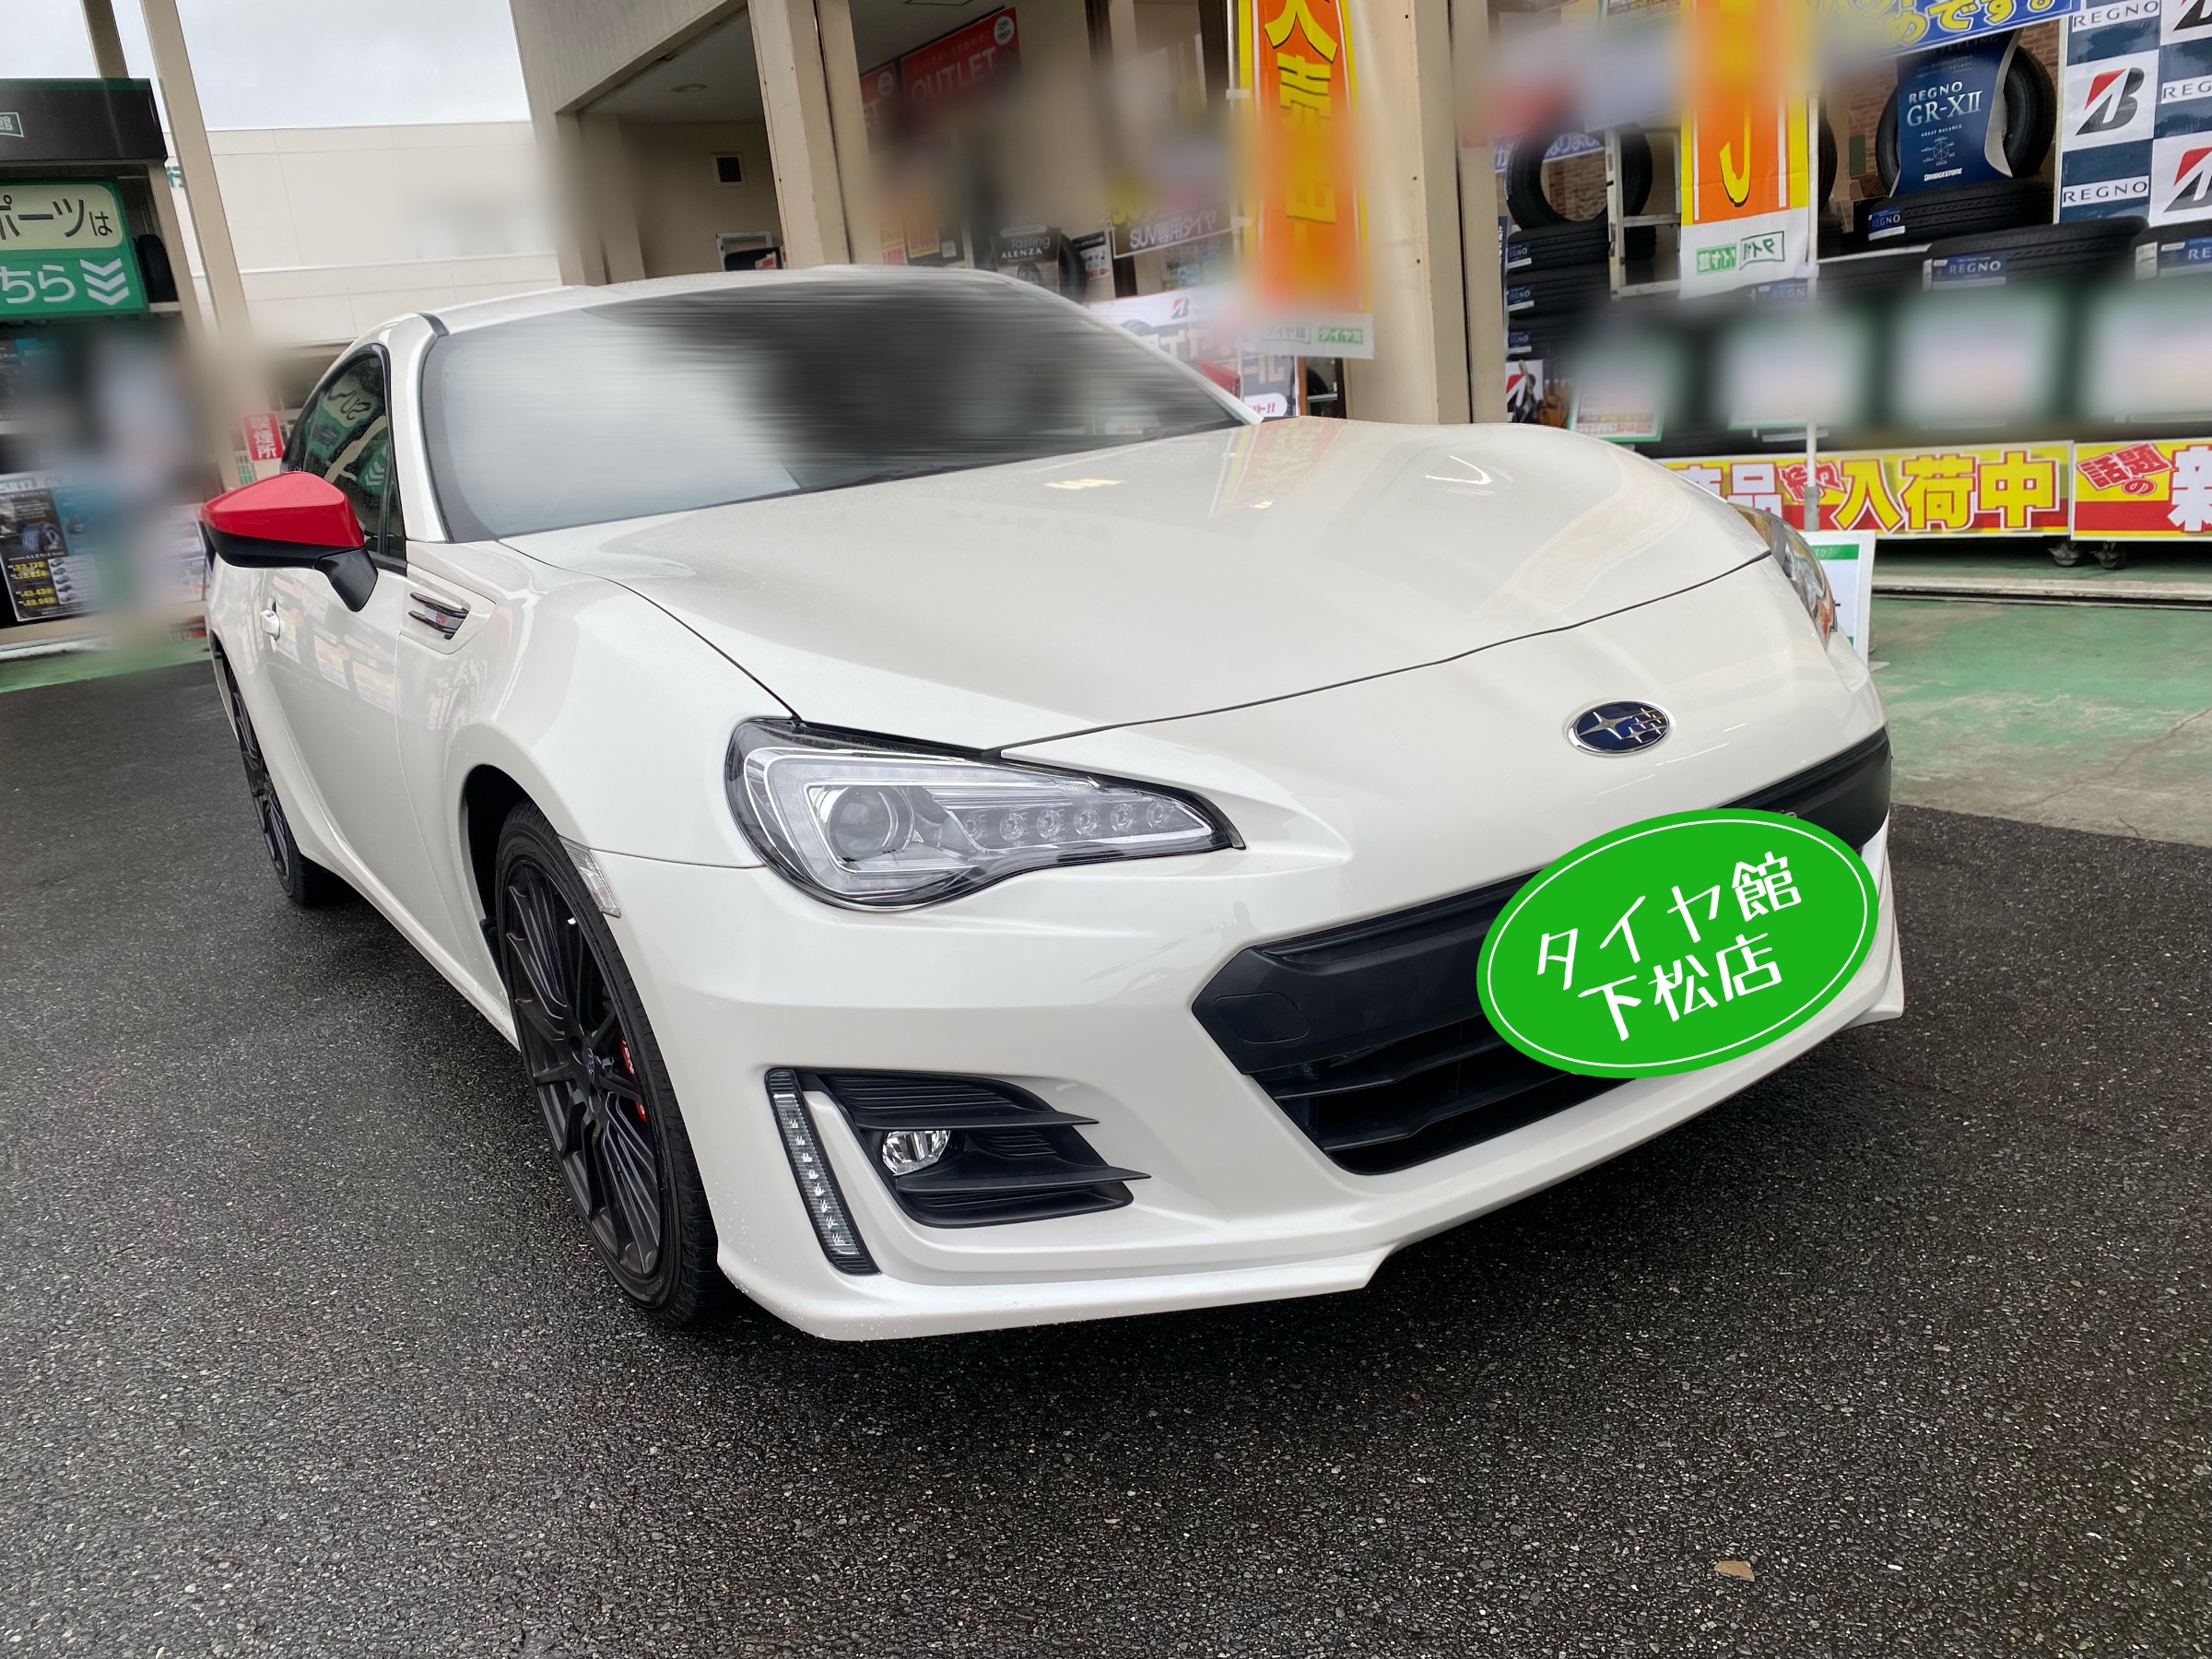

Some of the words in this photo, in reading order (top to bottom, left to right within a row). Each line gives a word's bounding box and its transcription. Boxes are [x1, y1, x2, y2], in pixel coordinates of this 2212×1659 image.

[2073, 1, 2159, 28] REGNO
[911, 46, 997, 103] OUTLET
[1908, 81, 1963, 103] REGNO
[1924, 168, 1963, 182] BRIDGESTONE
[2063, 181, 2148, 203] REGNO
[1011, 234, 1051, 250] Tasting
[1001, 246, 1043, 259] ALENZA
[1948, 260, 2002, 275] REGNO
